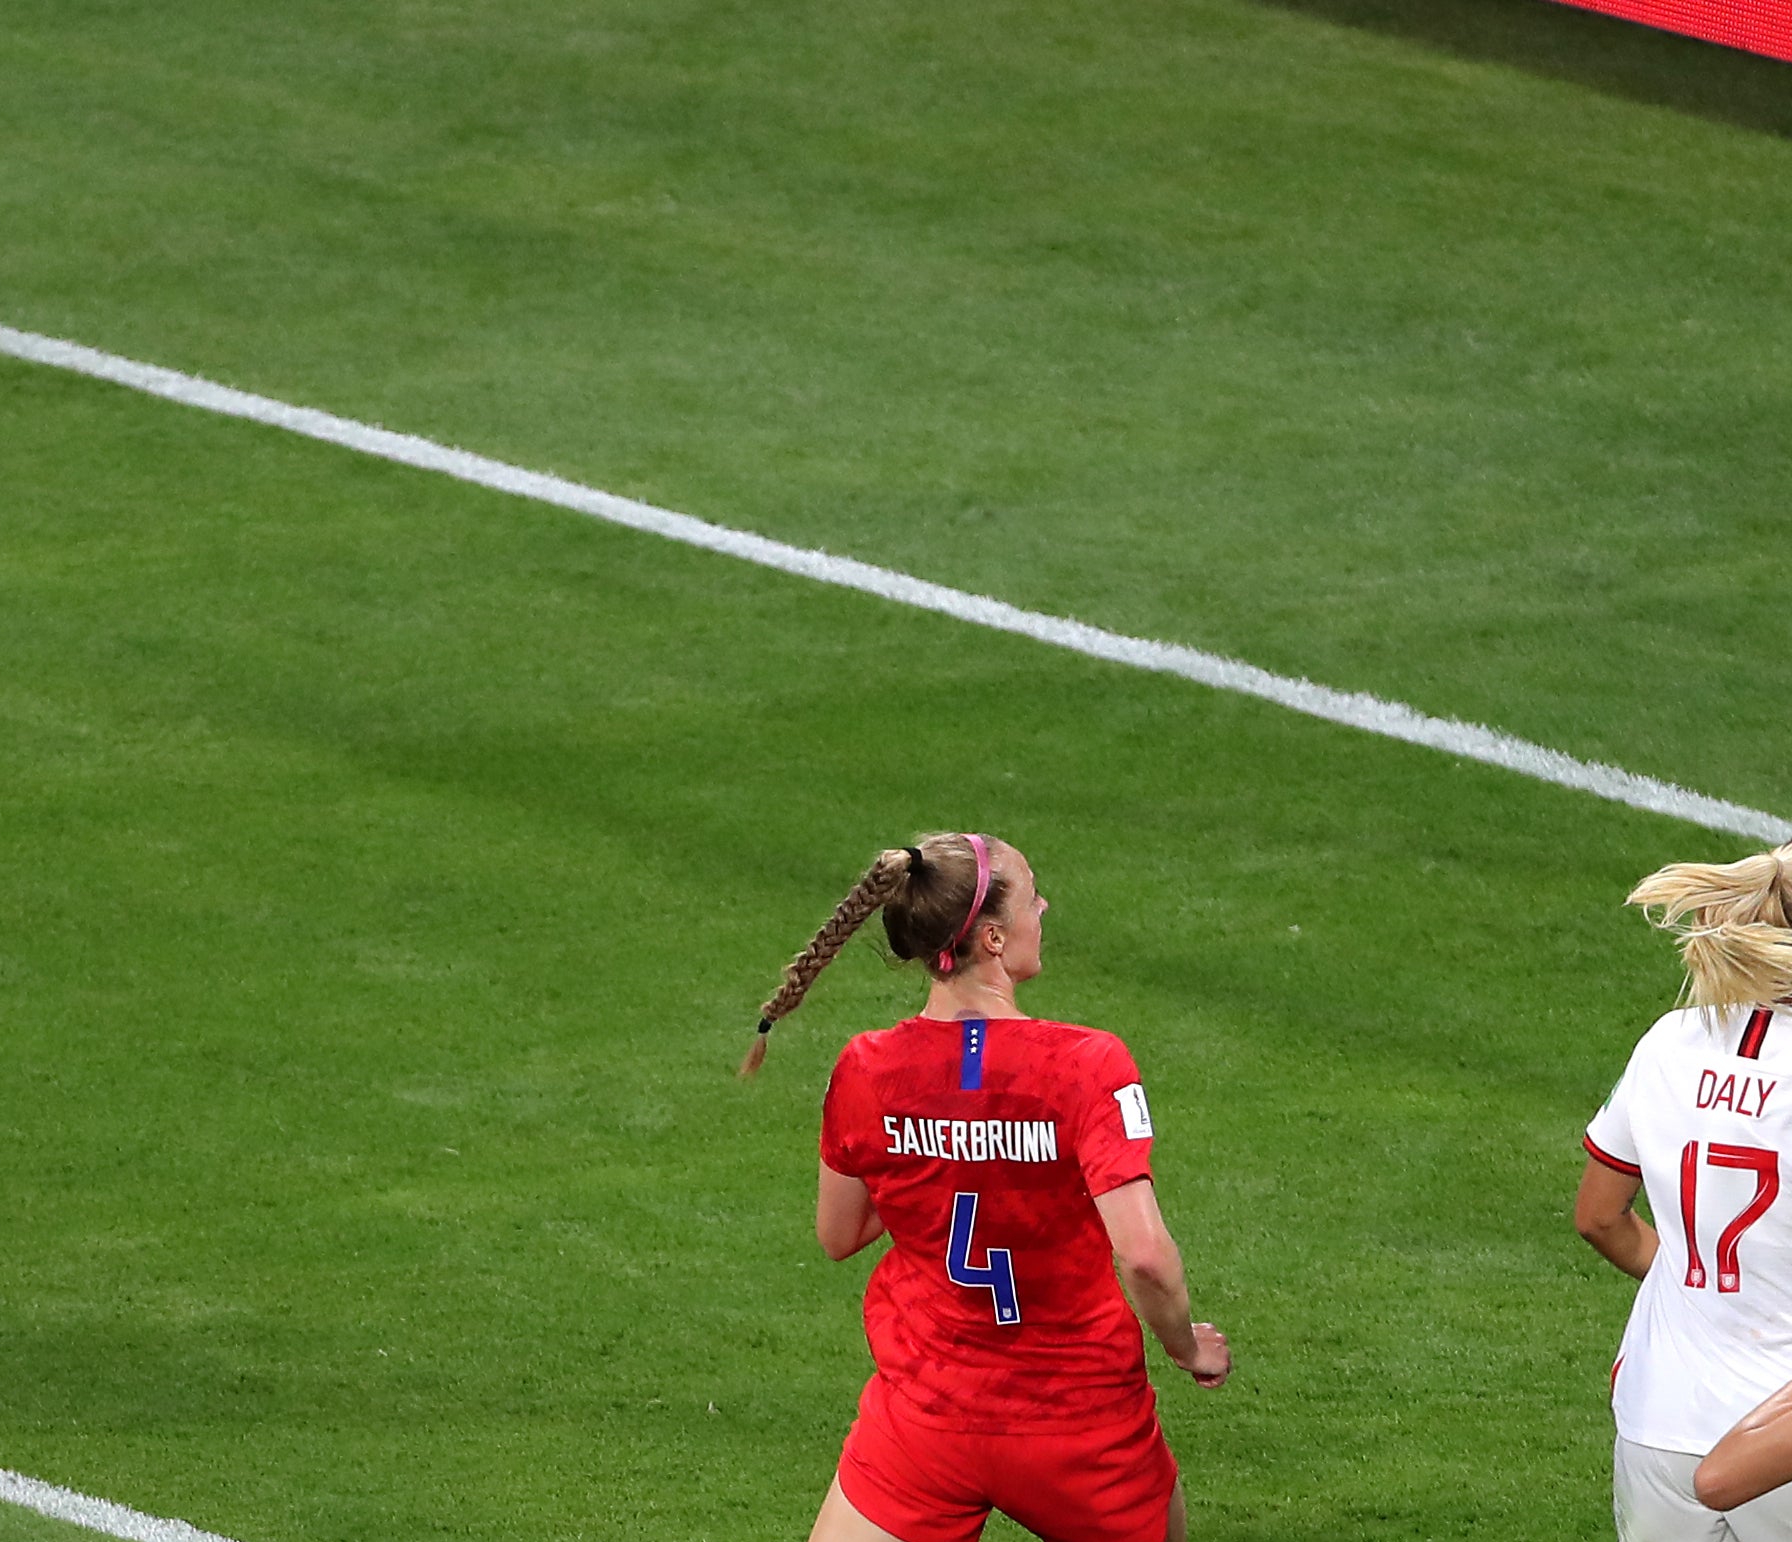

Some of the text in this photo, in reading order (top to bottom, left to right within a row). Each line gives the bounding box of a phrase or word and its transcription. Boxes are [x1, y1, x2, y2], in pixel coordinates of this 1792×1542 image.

[883, 1115, 1058, 1162] SAUERBRUNN
[1696, 1069, 1777, 1118] DALY
[945, 1191, 1021, 1325] 4
[1680, 1140, 1780, 1293] 17
